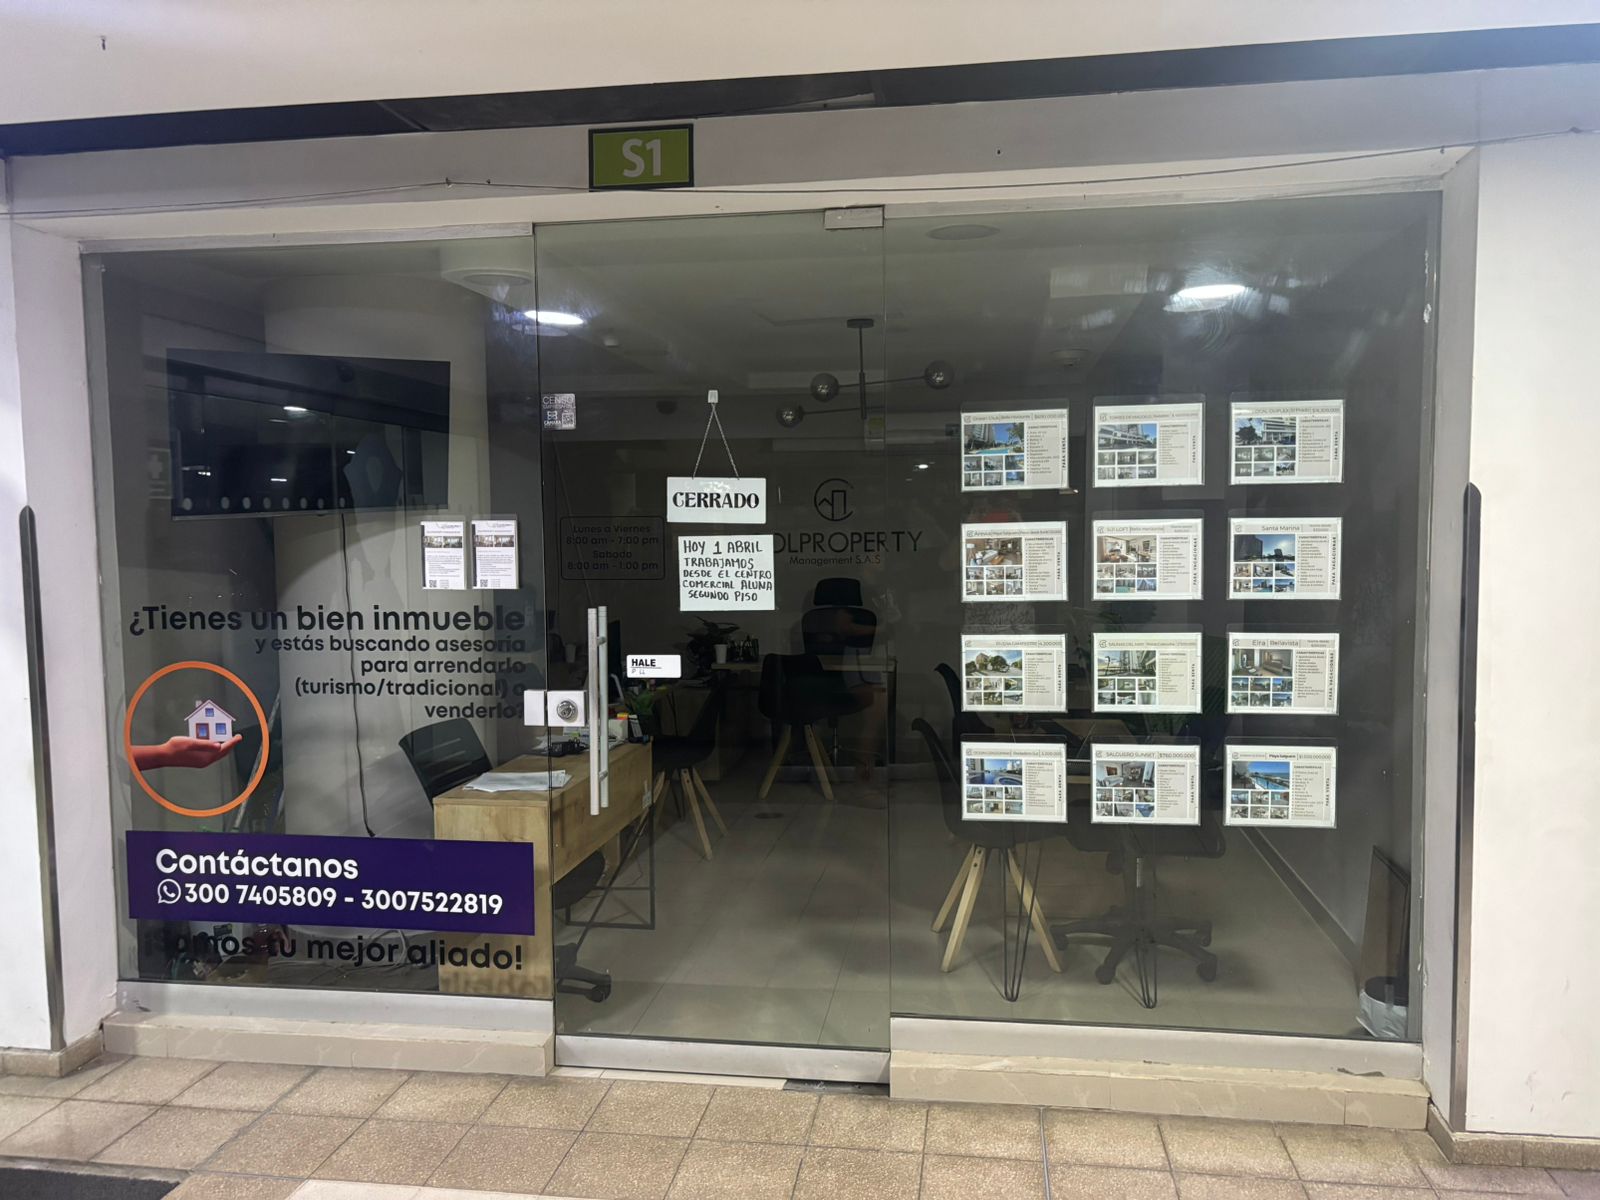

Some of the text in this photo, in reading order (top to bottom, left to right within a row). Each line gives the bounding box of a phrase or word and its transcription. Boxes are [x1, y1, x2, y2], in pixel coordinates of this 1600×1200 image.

[622, 138, 661, 177] S1
[672, 491, 760, 509] CERRADO
[573, 525, 602, 533] Lunes
[614, 525, 650, 533] Viernes
[642, 537, 659, 547] pm
[683, 540, 763, 555] HOY 1 ABRIL
[773, 531, 923, 553] OLPROPERTY
[592, 562, 608, 570] am
[641, 562, 659, 572] pm
[684, 557, 755, 569] TRABAJAMOS
[789, 556, 852, 566] Management
[683, 569, 773, 579] DESDE EL CENTRO
[682, 580, 773, 591] COMERCIAL ALUNA
[688, 590, 758, 602] SEGUNDO PISO
[130, 605, 525, 635] ¿Tienes un bien inmueble
[255, 635, 526, 654] y estás buscando asesoría
[361, 657, 526, 676] para arrendarlo
[631, 658, 656, 667] HALE
[295, 677, 508, 698] (turismo/tradicional)
[156, 848, 359, 880] Contáctanos
[184, 883, 230, 904] 300
[236, 884, 337, 907] 7405809
[361, 889, 503, 915] 3007522819
[307, 935, 398, 967] mejor
[407, 938, 522, 970] aliado!
